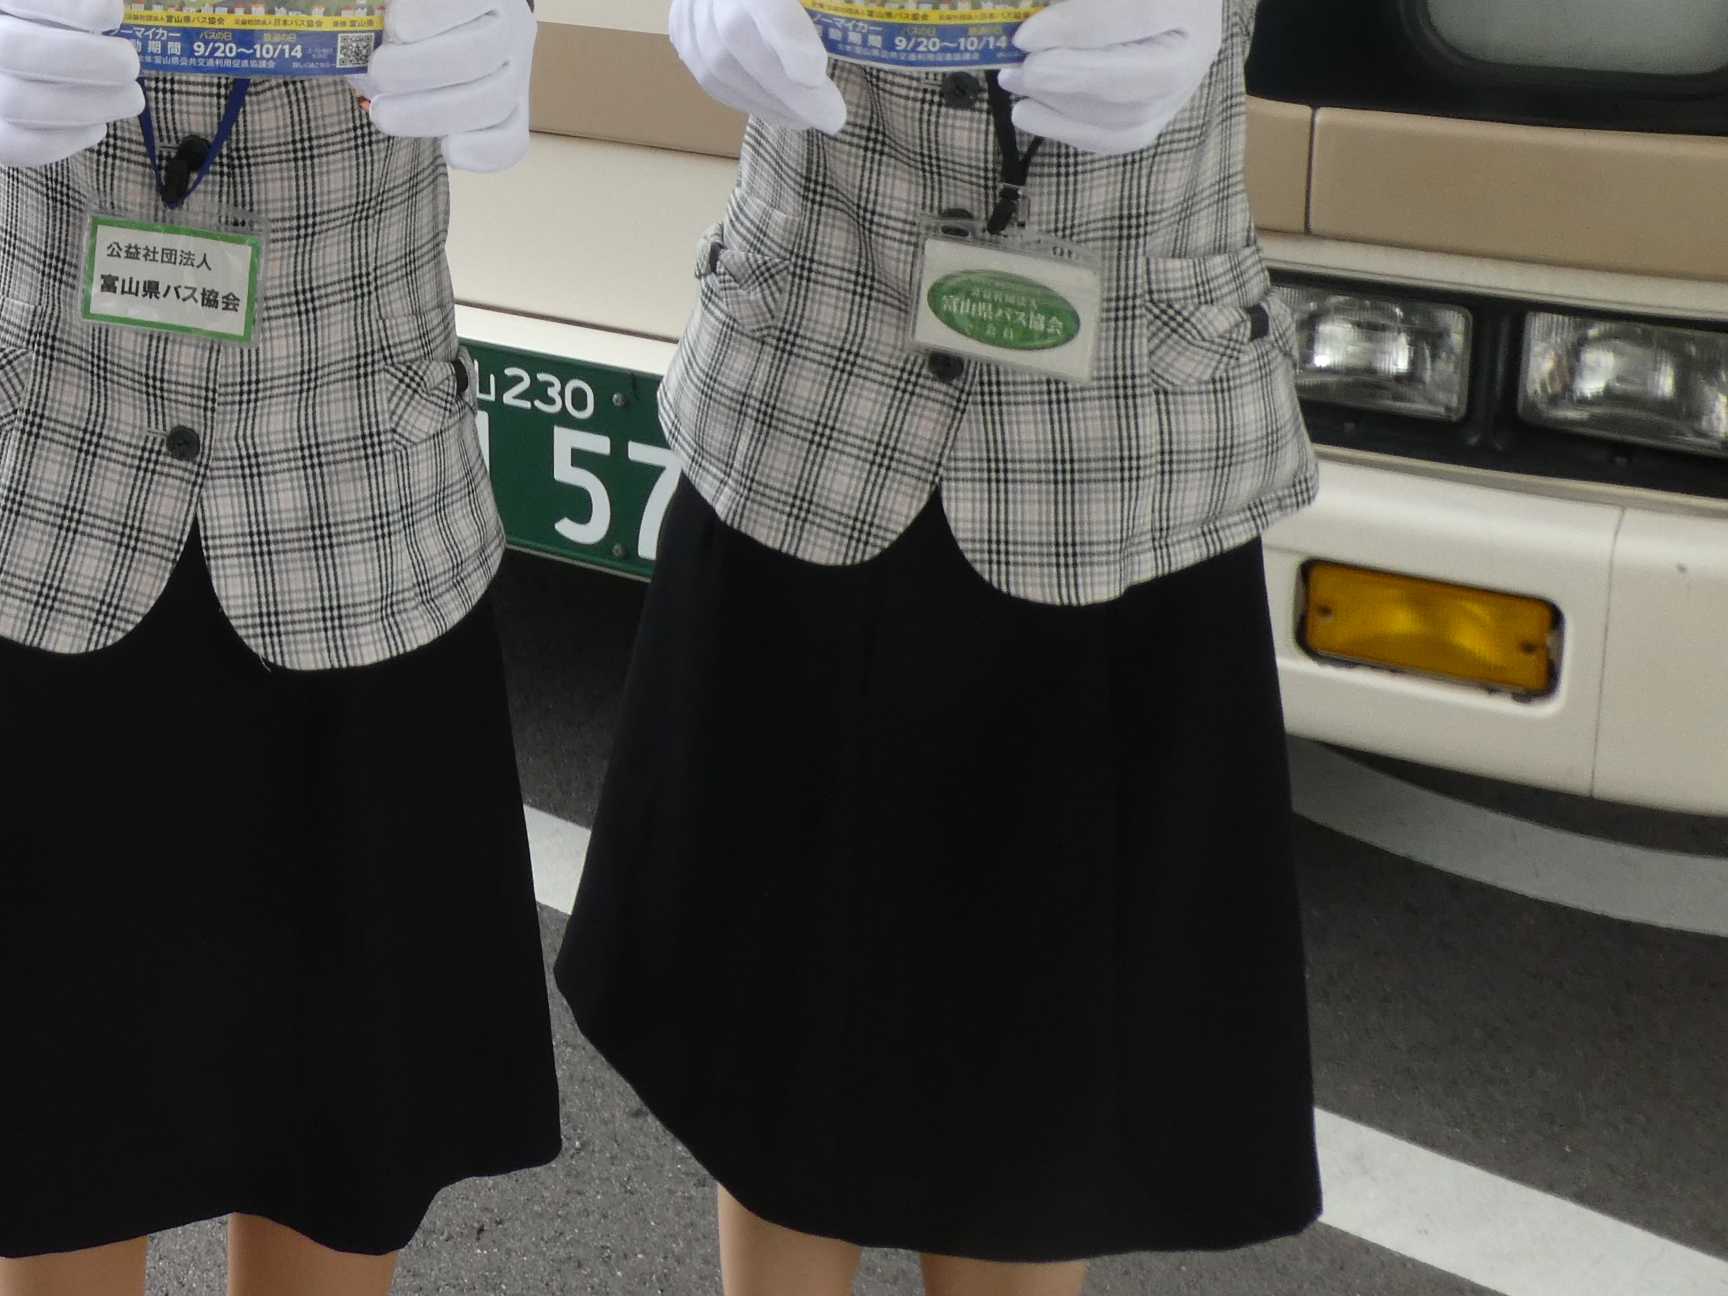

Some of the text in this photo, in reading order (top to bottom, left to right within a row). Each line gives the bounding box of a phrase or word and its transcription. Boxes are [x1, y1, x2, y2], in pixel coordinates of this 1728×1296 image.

[106, 240, 213, 272] 公益社団法人
[99, 273, 241, 313] 富山県バス協会
